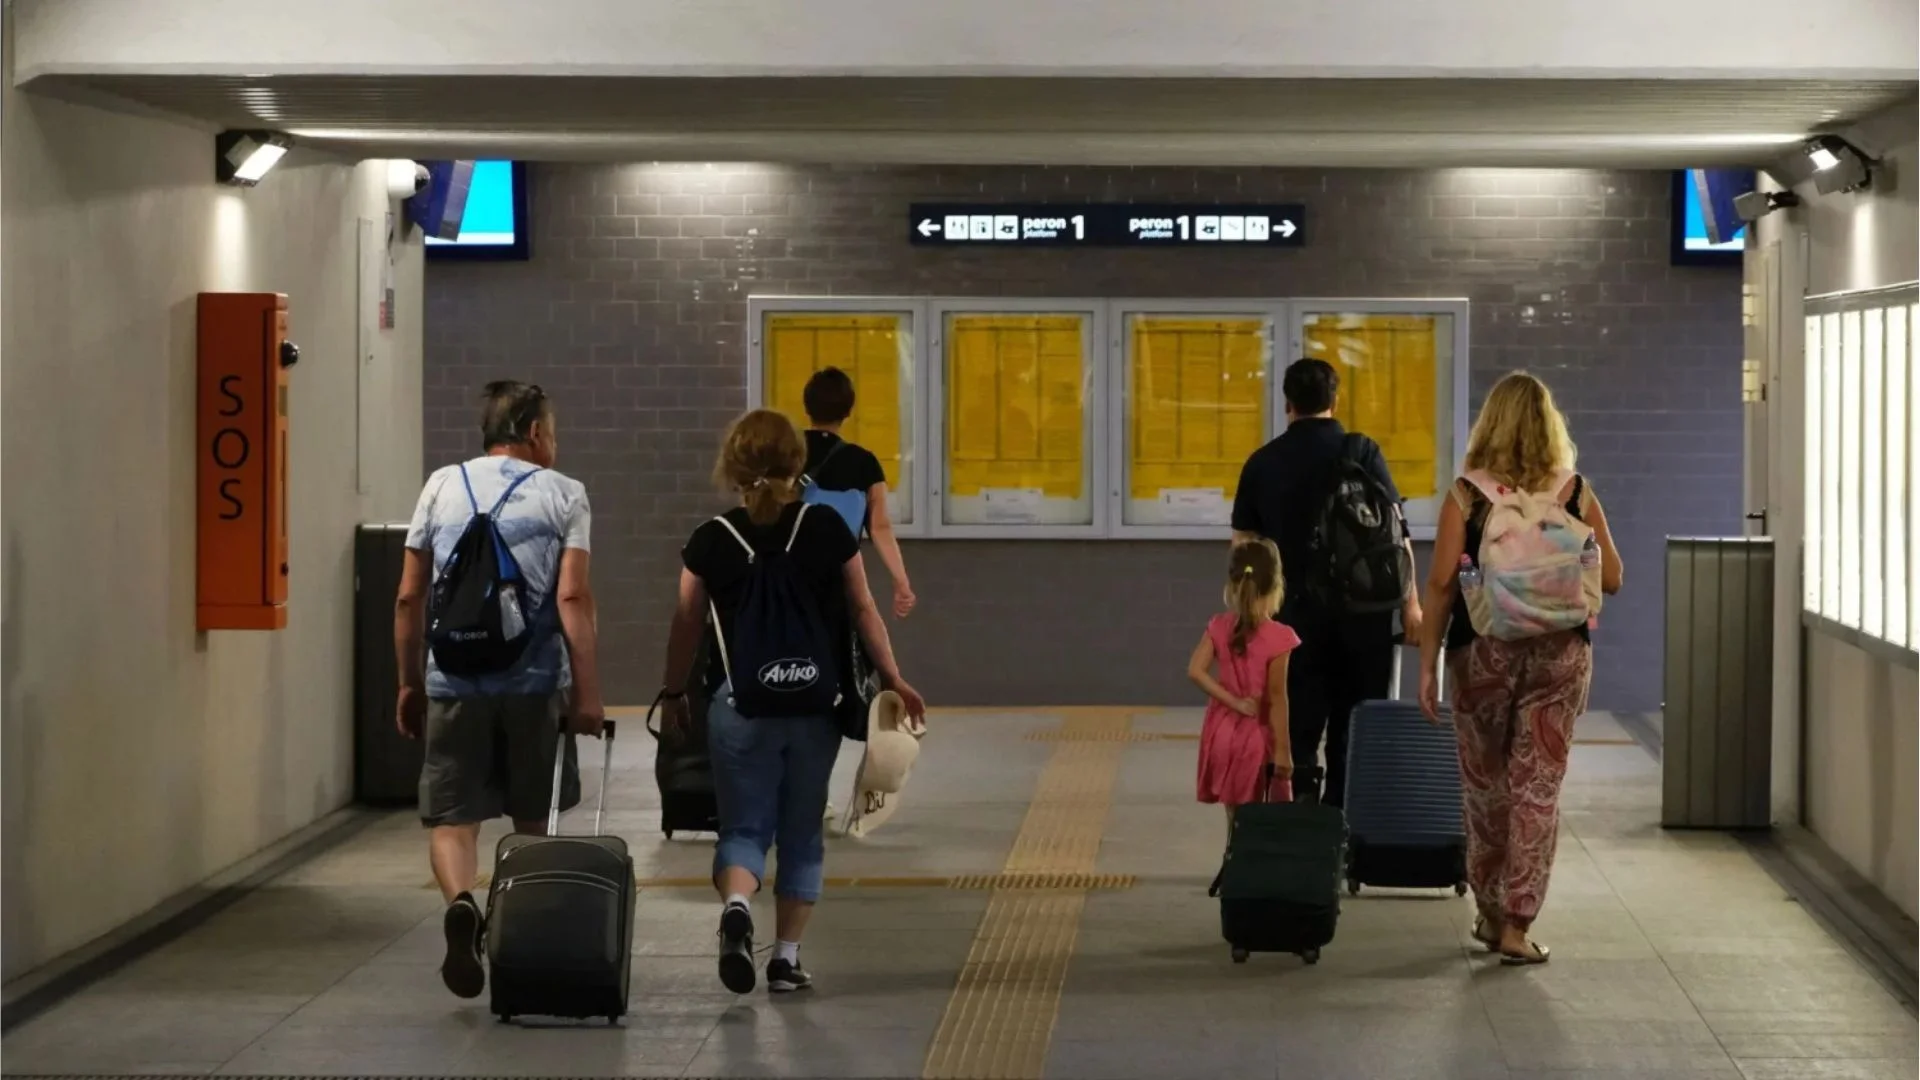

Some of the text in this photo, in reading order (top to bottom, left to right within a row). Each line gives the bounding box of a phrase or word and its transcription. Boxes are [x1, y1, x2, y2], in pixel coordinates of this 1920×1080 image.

[1022, 214, 1085, 240] peron 1
[1023, 230, 1057, 240] platform
[1129, 214, 1190, 240] peron 1
[1139, 229, 1173, 240] platform
[211, 374, 250, 521] SOS
